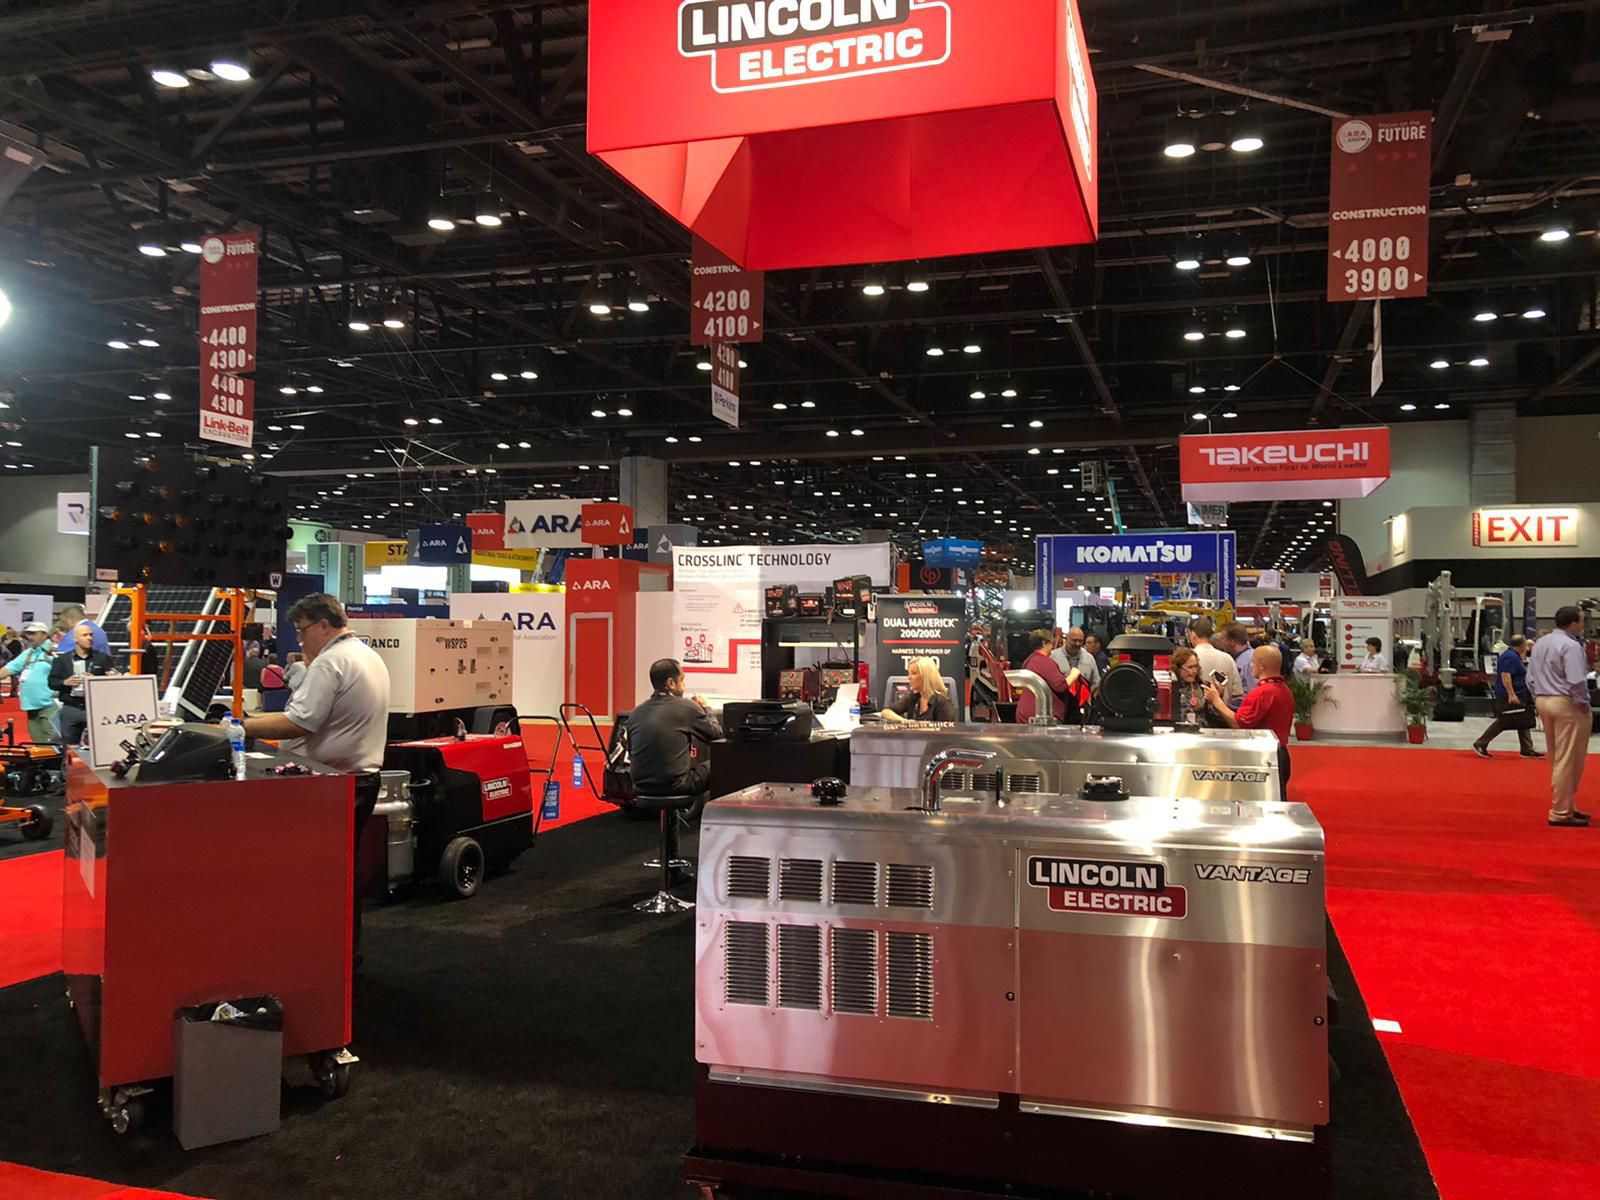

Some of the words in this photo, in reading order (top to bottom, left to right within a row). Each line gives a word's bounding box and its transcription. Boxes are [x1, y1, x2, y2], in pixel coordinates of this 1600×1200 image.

[739, 28, 923, 80] ELECTRIC
[1377, 125, 1427, 143] FUTURE
[1332, 205, 1426, 220] CONSTRUCTION
[226, 242, 255, 256] FUTURE
[1344, 236, 1410, 262] 4000
[1344, 266, 1409, 293] 3900
[201, 302, 256, 314] CONSTRUCTION
[703, 289, 750, 312] 4200
[704, 315, 748, 337] 4100
[209, 326, 247, 346] 4400
[209, 349, 246, 369] 4300
[211, 373, 245, 396] 4400
[211, 394, 243, 416] 4300
[204, 416, 249, 436] Link-Belt
[476, 528, 495, 536] ARA
[591, 519, 611, 527] ARA
[1488, 516, 1568, 542] EXIT
[750, 553, 832, 566] TECHNOLOGY
[1077, 541, 1192, 563] KOMATSU
[583, 580, 611, 590] ARA
[883, 618, 906, 628] DUAL
[444, 637, 468, 649] WSP25
[900, 629, 941, 638] 200/200X
[901, 655, 940, 671] TO
[114, 713, 148, 724] ARA
[1192, 770, 1268, 782] VANTAGE
[484, 780, 508, 792] LINCOLN
[1035, 861, 1157, 889] LINCOLN
[1194, 864, 1310, 884] VANTAGE
[1063, 890, 1172, 913] ELECTRIC
